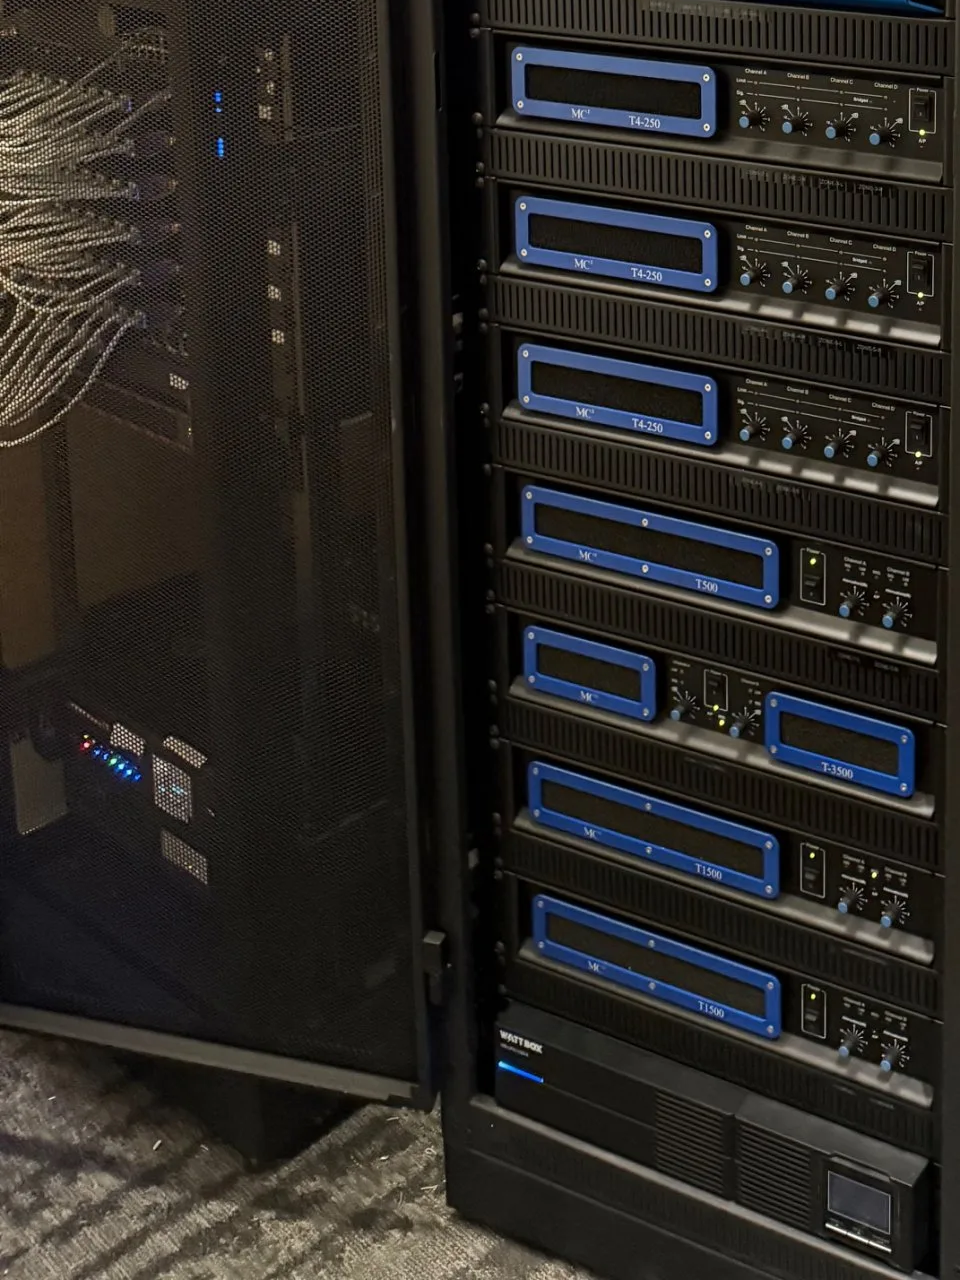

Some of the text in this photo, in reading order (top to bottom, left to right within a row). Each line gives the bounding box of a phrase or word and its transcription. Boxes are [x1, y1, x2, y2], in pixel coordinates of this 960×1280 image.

[628, 115, 661, 129] T4-250
[829, 236, 847, 244] Channel
[873, 243, 890, 251] Channel
[630, 267, 663, 282] T4-250
[746, 378, 762, 386] Channel
[829, 394, 846, 402] Channel
[872, 402, 889, 410] Channel
[631, 418, 663, 433] T4-250
[695, 578, 718, 593] T500
[579, 689, 599, 704] MC
[821, 761, 854, 780] T-3500
[583, 825, 599, 840] MC
[695, 863, 722, 881] T1500
[587, 960, 606, 974] MC
[698, 1000, 725, 1018] T1500
